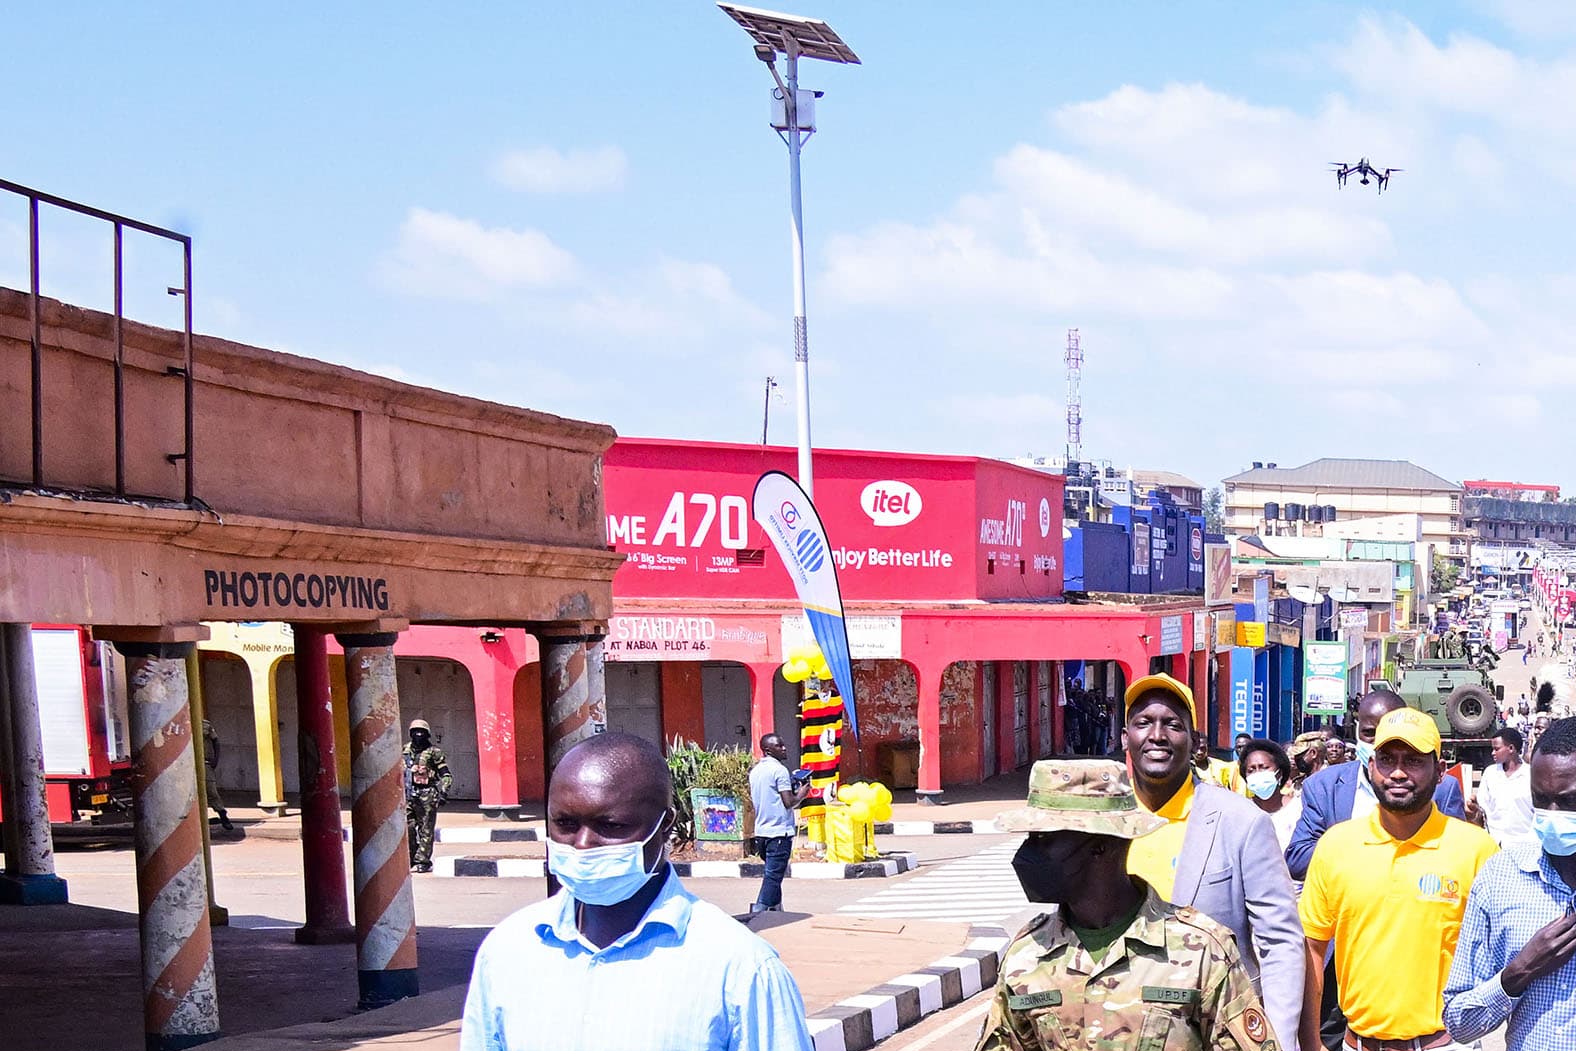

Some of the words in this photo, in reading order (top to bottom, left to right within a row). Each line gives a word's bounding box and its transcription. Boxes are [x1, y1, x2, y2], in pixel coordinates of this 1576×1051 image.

[873, 490, 910, 515] itel
[606, 515, 646, 545] ME
[652, 491, 748, 550] A70
[641, 553, 654, 565] Big
[656, 554, 687, 565] Screen
[712, 556, 734, 566] 13MP
[833, 547, 867, 570] njoy
[868, 548, 920, 567] Better
[922, 550, 952, 568] Life
[204, 570, 389, 610] PHOTOCOPYING
[617, 616, 716, 640] STANDARD
[243, 643, 271, 653] Mobile
[273, 644, 294, 653] Mon
[610, 641, 622, 650] AT
[664, 641, 689, 650] PLOT
[1235, 678, 1248, 732] TECNO
